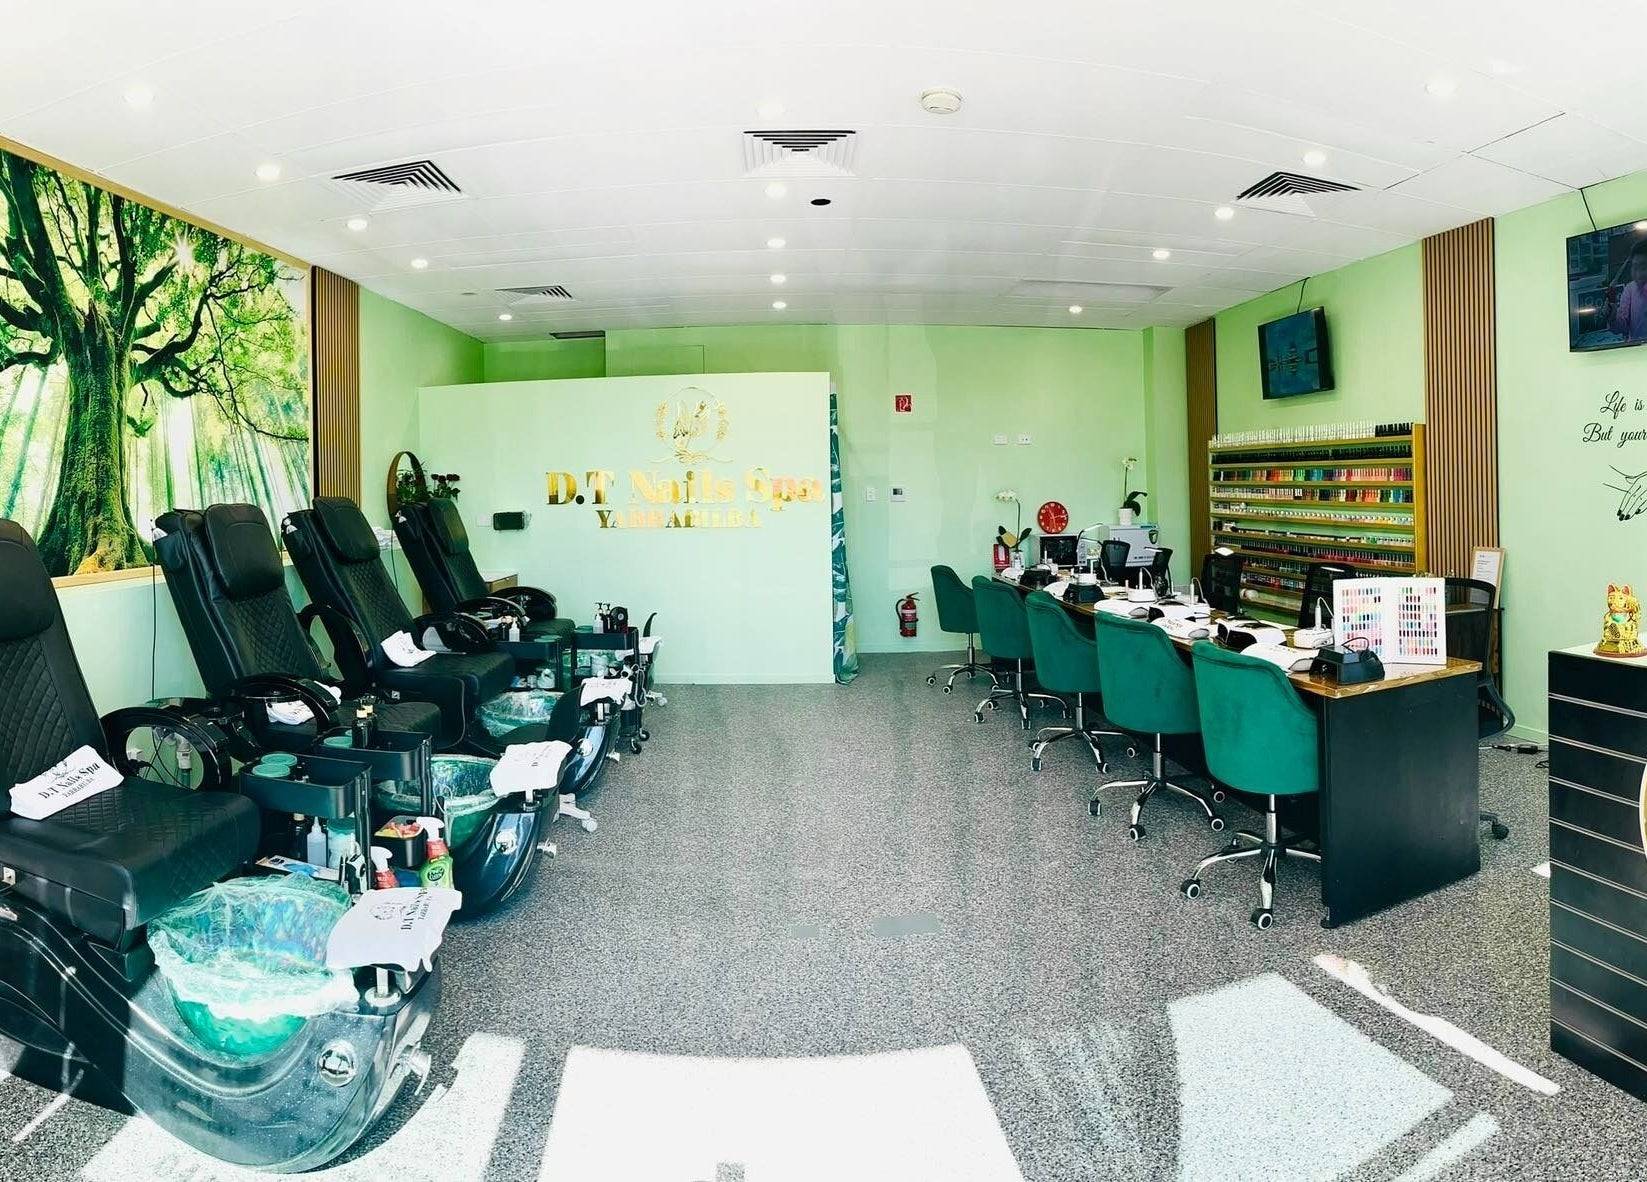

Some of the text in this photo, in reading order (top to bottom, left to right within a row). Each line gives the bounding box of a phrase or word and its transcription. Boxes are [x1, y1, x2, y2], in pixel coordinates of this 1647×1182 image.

[1600, 390, 1645, 420] Life is
[1582, 422, 1647, 448] But your
[545, 467, 826, 511] D.T Nails Spa
[78, 762, 101, 777] Spa
